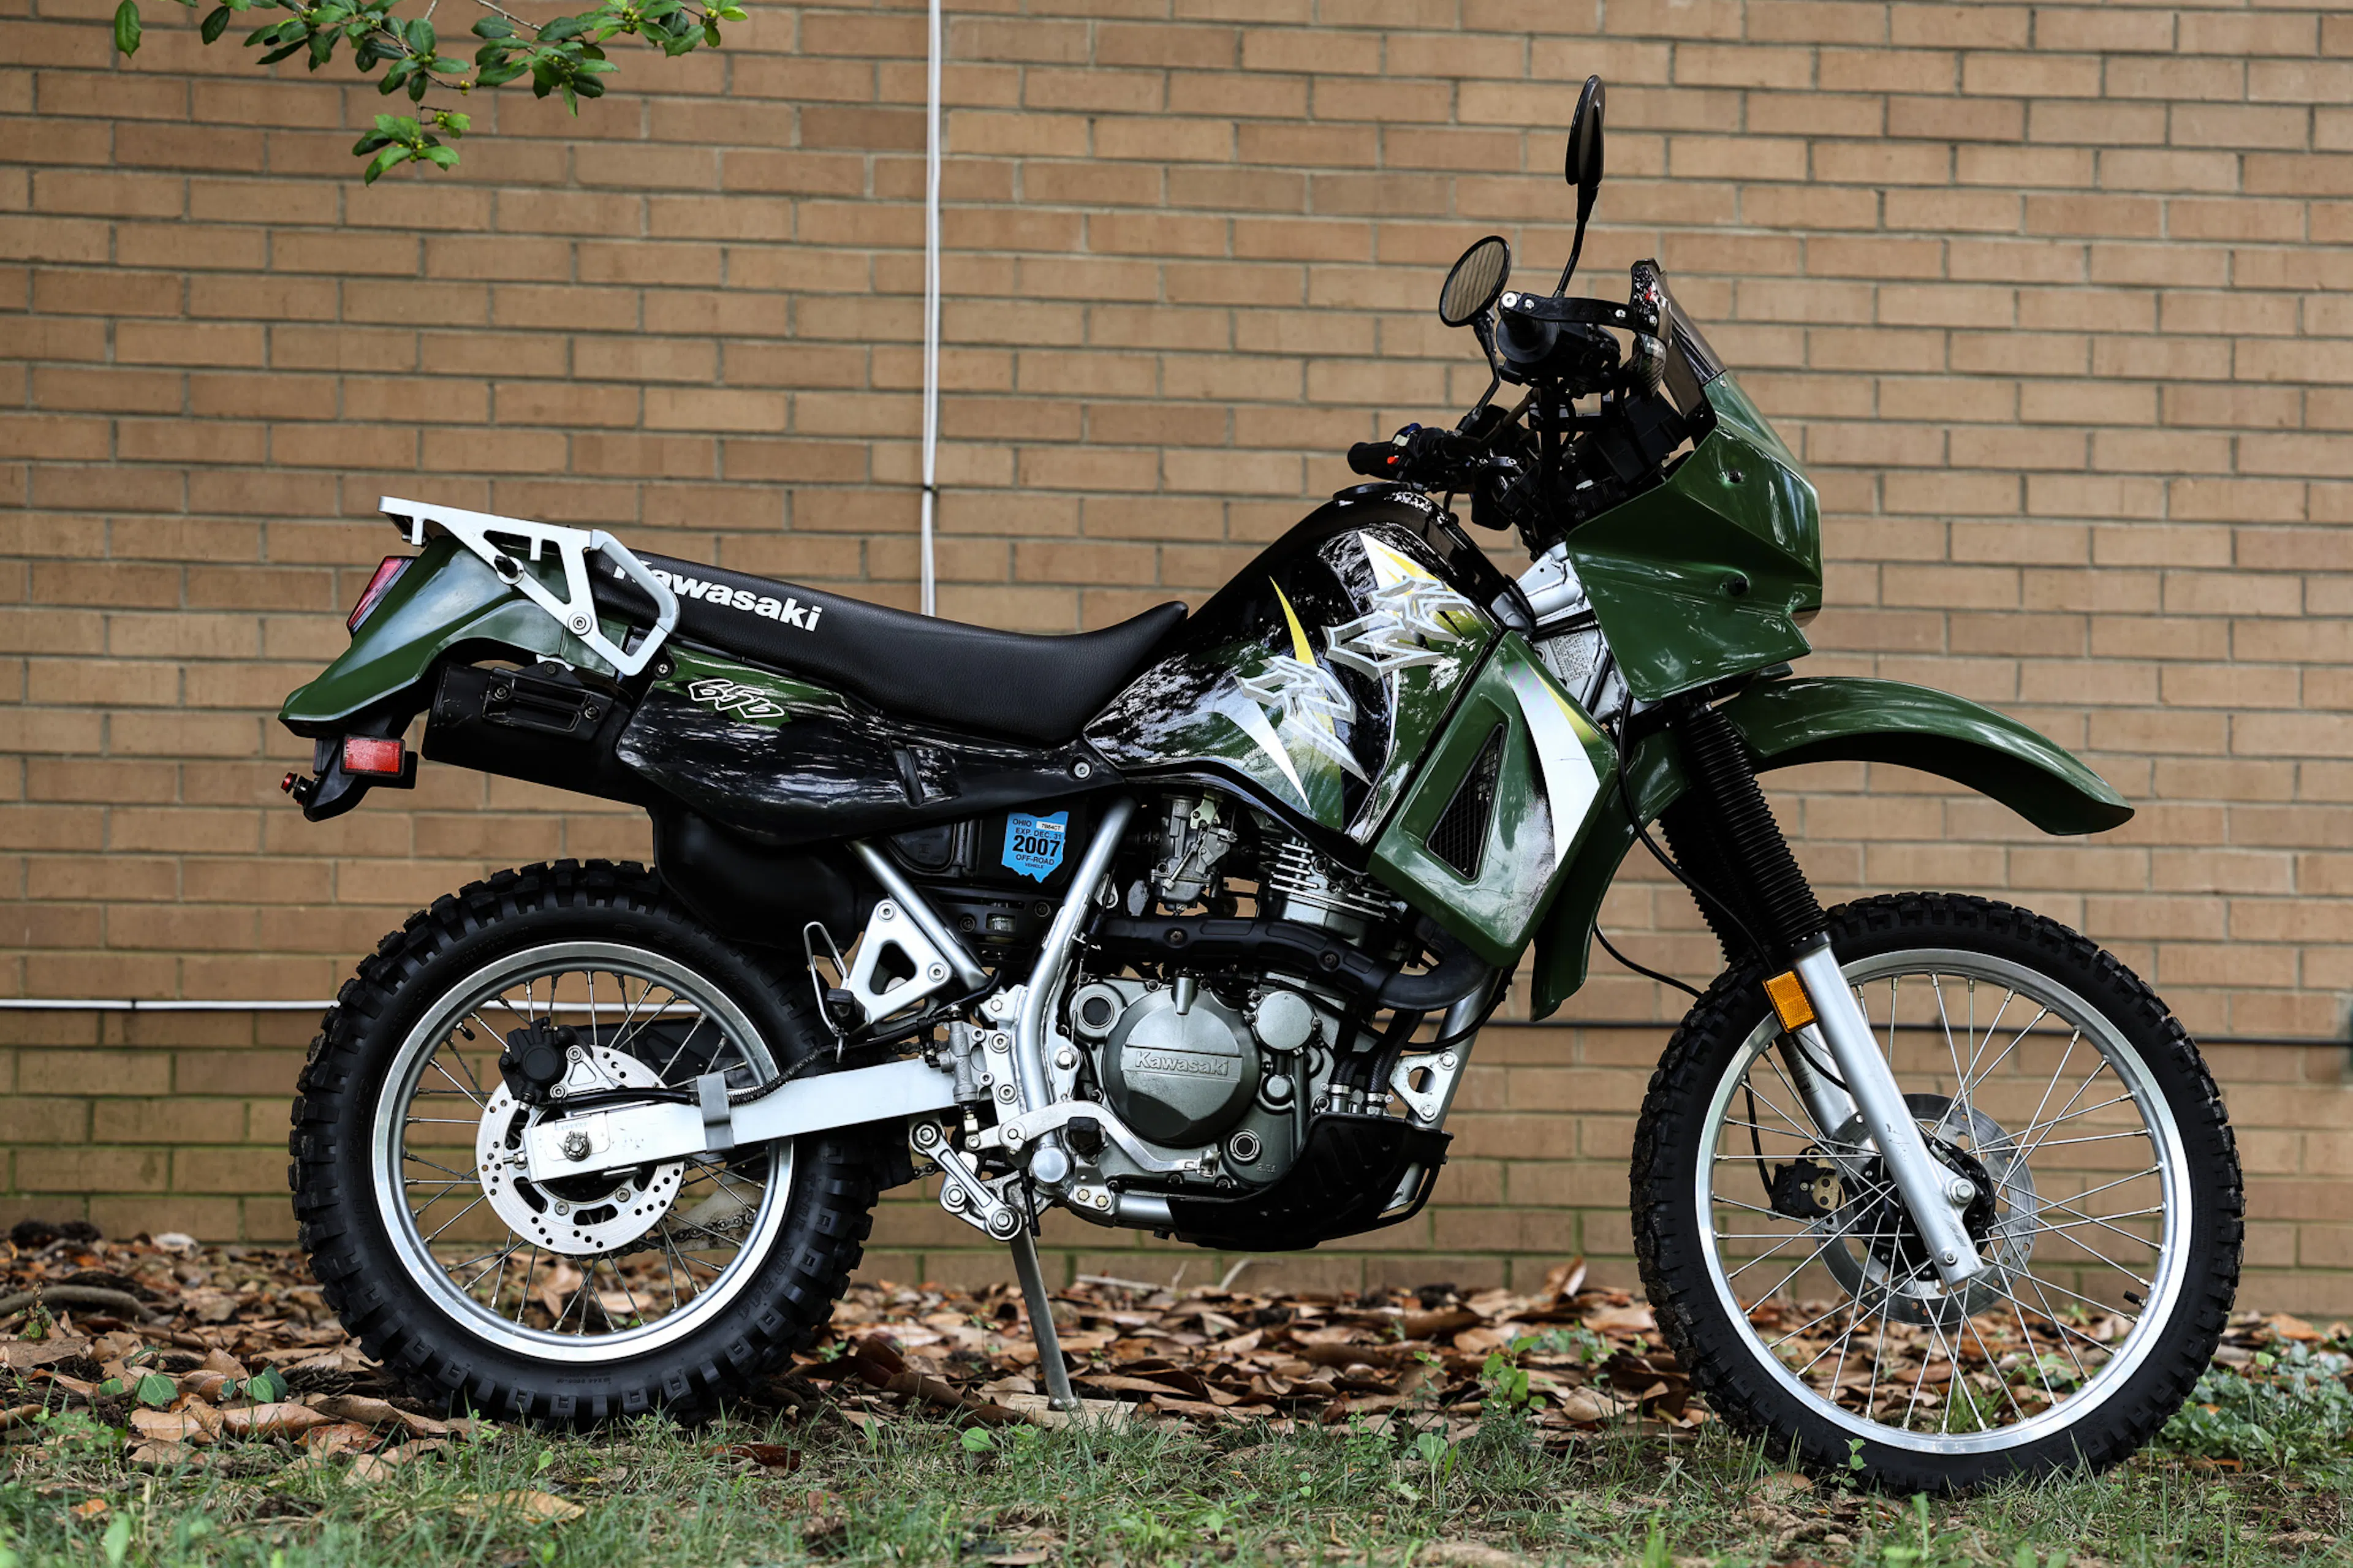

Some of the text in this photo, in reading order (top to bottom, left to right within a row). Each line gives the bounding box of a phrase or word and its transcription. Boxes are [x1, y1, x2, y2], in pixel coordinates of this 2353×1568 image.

[688, 679, 785, 718] 650
[1012, 818, 1032, 827] OHIO
[1012, 835, 1061, 857] 2007
[1015, 854, 1055, 865] OFF-ROAD
[1135, 1051, 1229, 1076] Kawasaki
